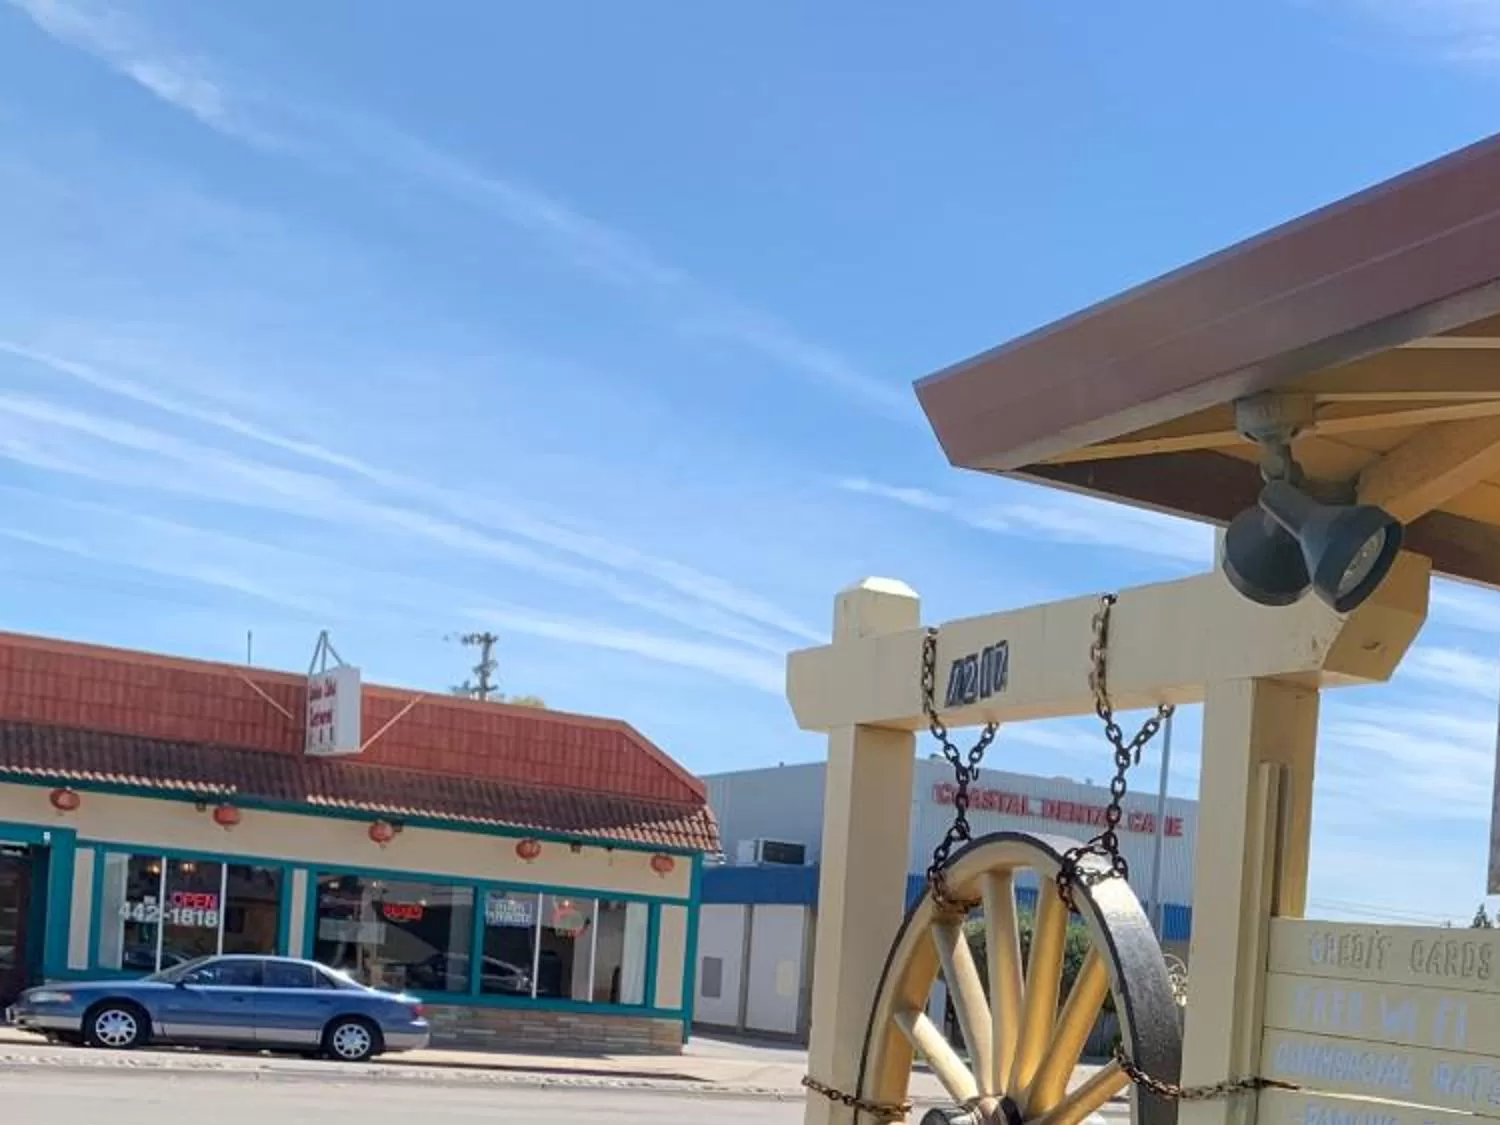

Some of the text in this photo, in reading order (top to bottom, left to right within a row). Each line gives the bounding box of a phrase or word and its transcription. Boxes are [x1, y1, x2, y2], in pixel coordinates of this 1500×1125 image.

[118, 901, 218, 928] 442-1818
[1308, 929, 1493, 981] CREDIT CARDS
